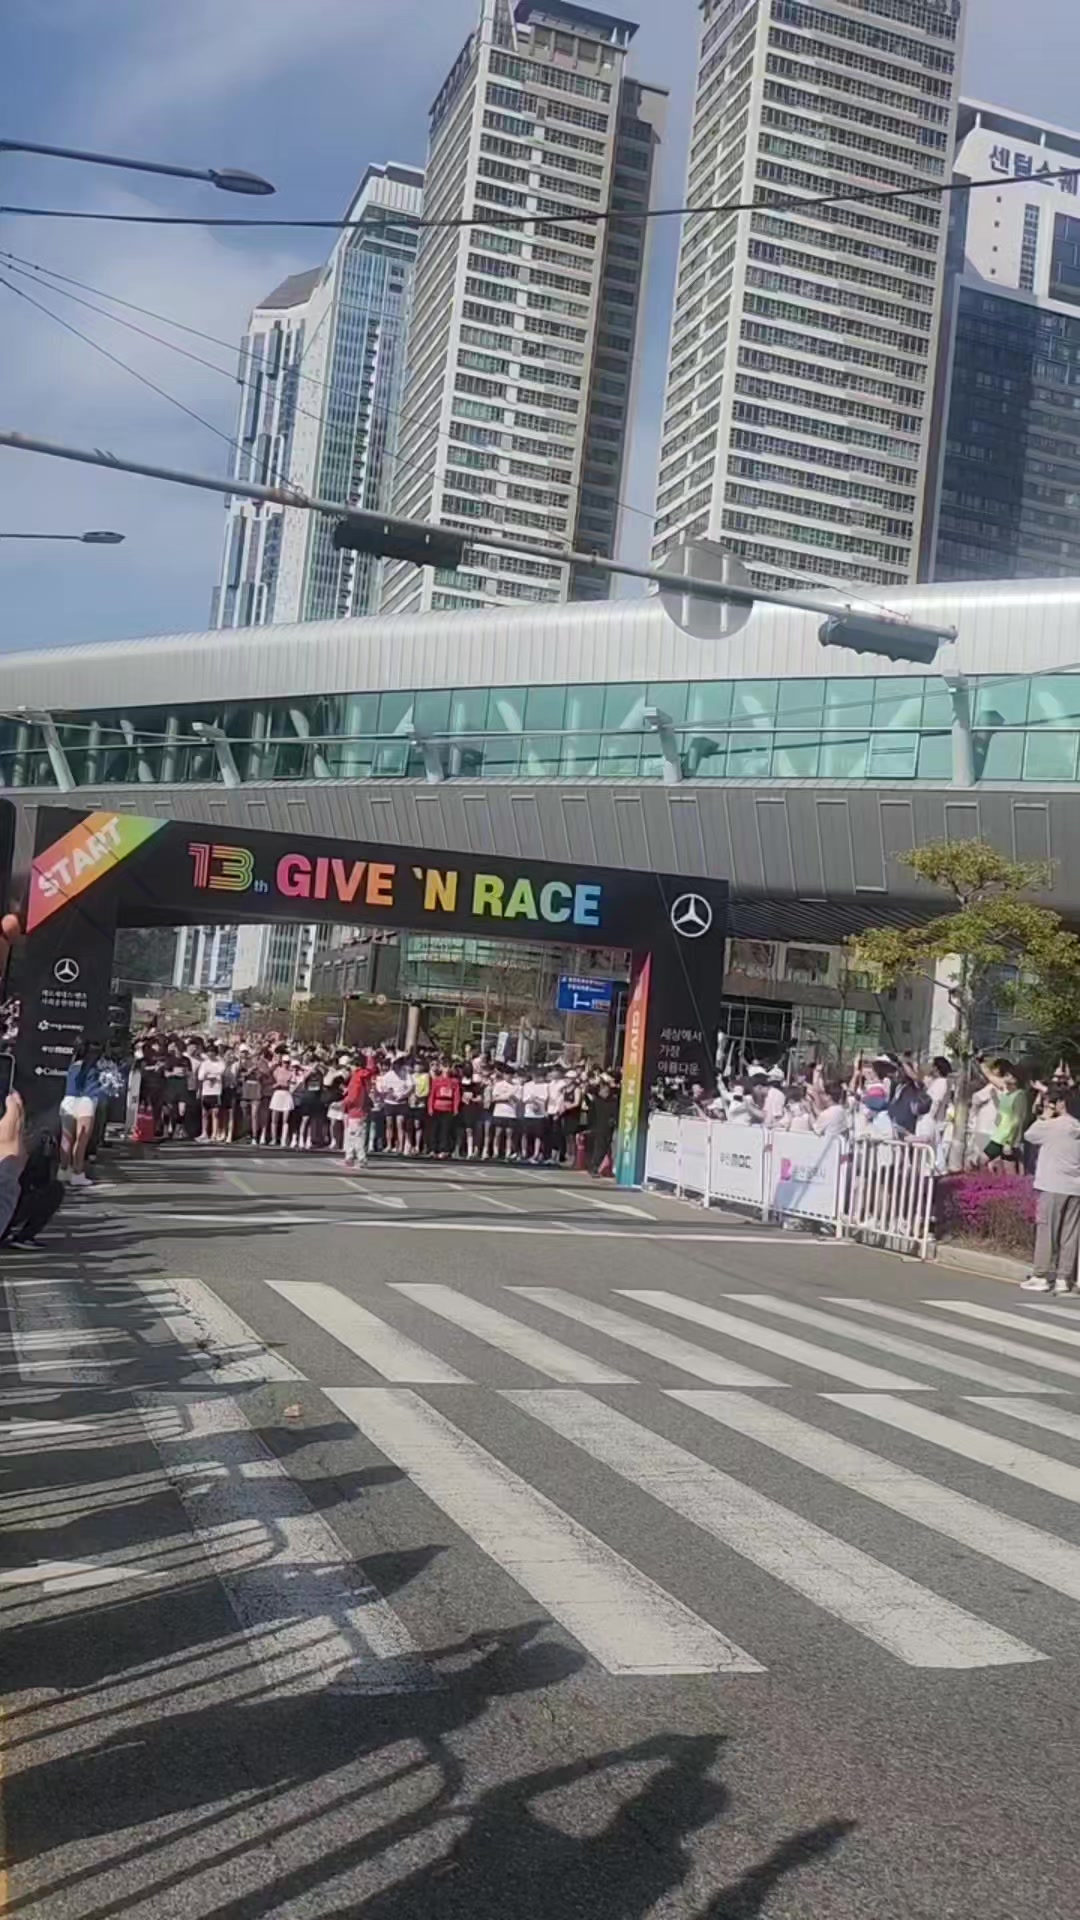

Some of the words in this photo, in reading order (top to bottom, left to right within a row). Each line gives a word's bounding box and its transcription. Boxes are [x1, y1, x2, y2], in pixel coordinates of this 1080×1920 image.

[38, 816, 121, 897] START
[276, 853, 396, 906] GIVE
[472, 873, 602, 926] RACE
[659, 1027, 703, 1043] 세상에서
[658, 1044, 681, 1059] 가장
[657, 1060, 701, 1076] 아름다운
